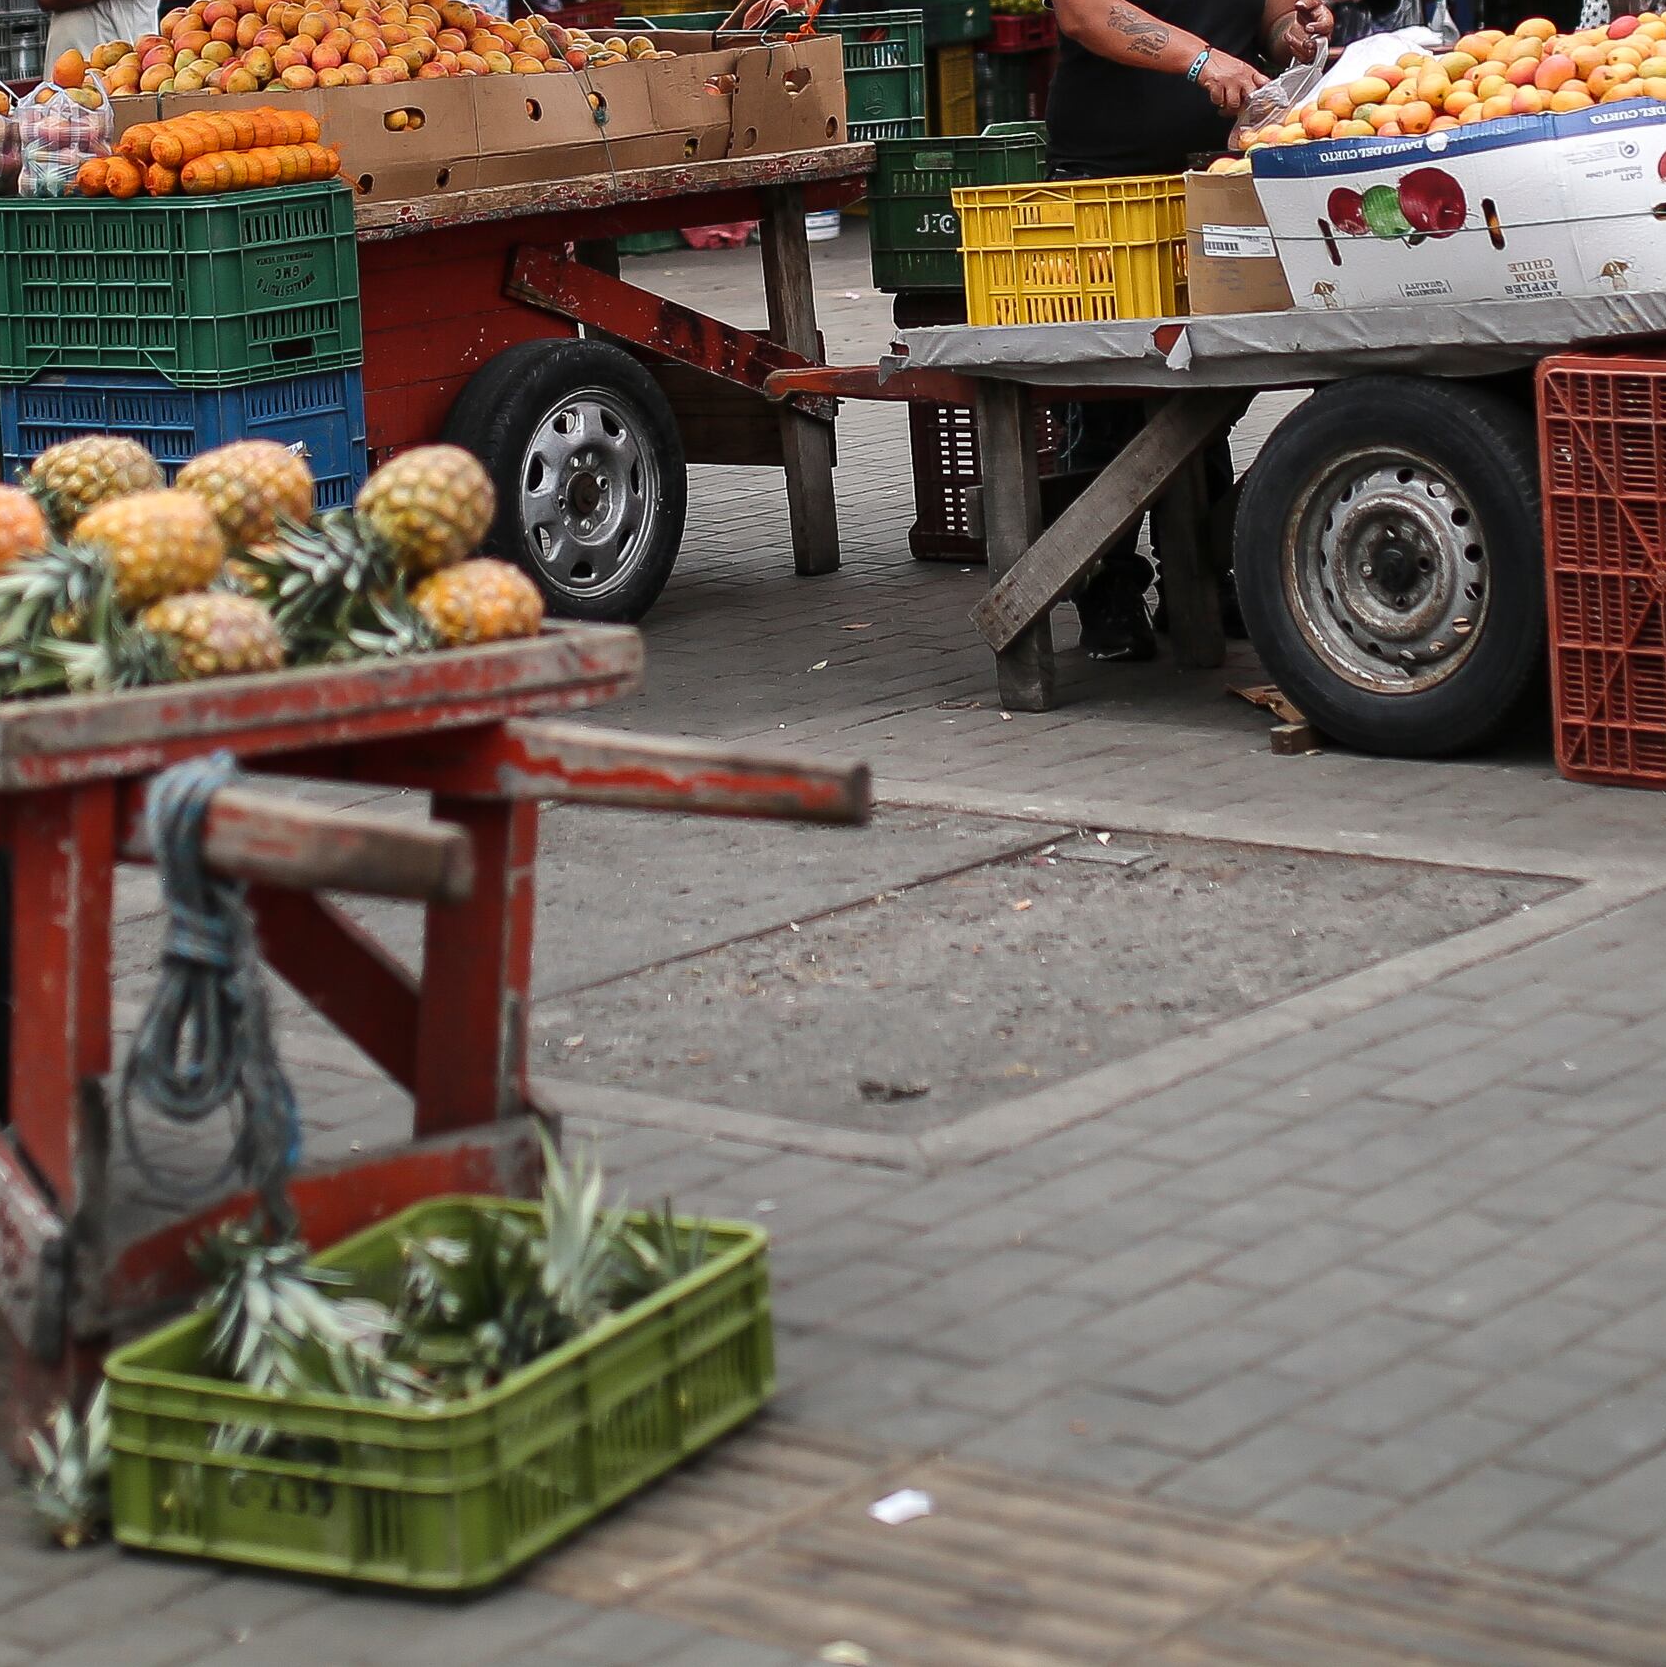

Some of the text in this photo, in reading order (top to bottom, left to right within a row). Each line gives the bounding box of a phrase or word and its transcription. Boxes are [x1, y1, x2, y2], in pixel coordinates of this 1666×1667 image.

[1588, 111, 1638, 125] CURTO
[1638, 105, 1666, 118] DEL
[1318, 139, 1424, 163] DAVID DEL CURTO
[1507, 257, 1553, 273] CHILE
[1514, 269, 1558, 283] FROM
[1504, 280, 1559, 295] APPLES
